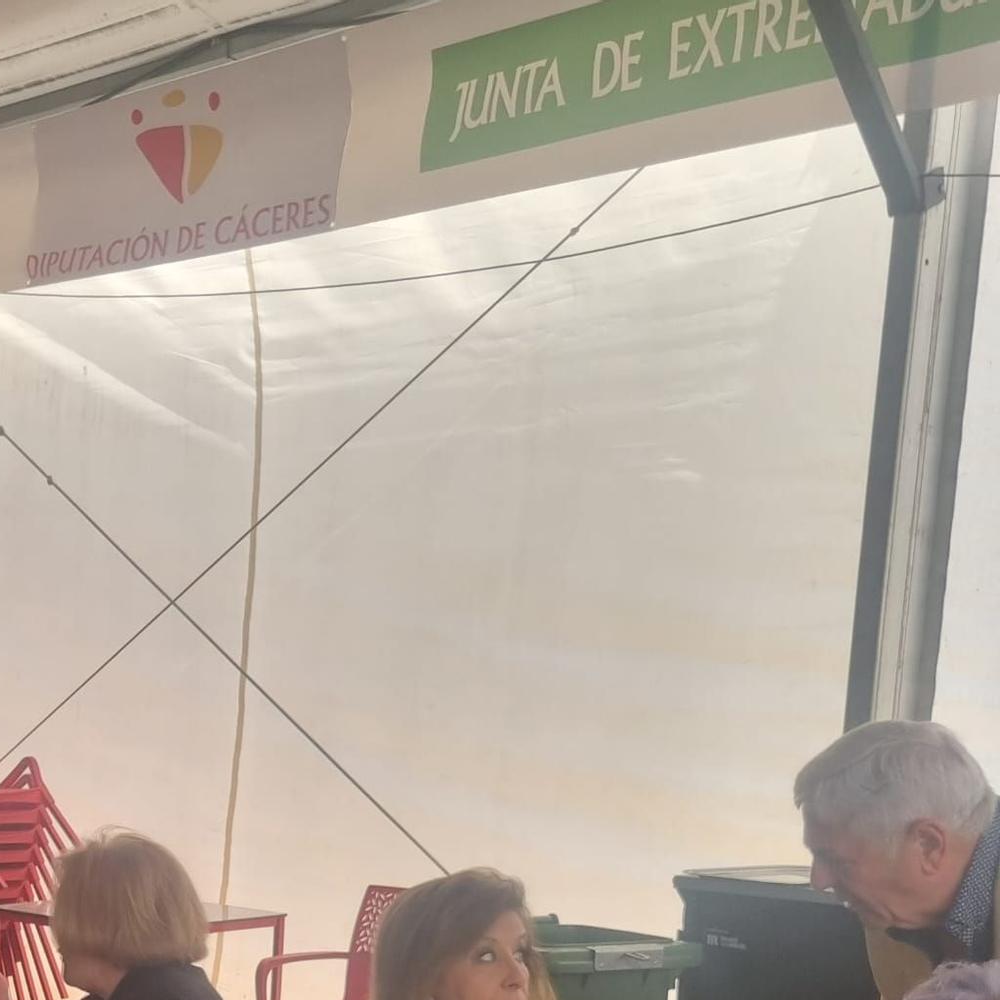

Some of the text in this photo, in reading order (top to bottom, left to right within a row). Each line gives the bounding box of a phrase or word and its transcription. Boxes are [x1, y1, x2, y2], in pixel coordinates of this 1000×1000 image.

[450, 57, 566, 143] JUNTA
[591, 30, 645, 99] DE
[25, 194, 333, 280] DIPUTACIÓN DE CÁCERES
